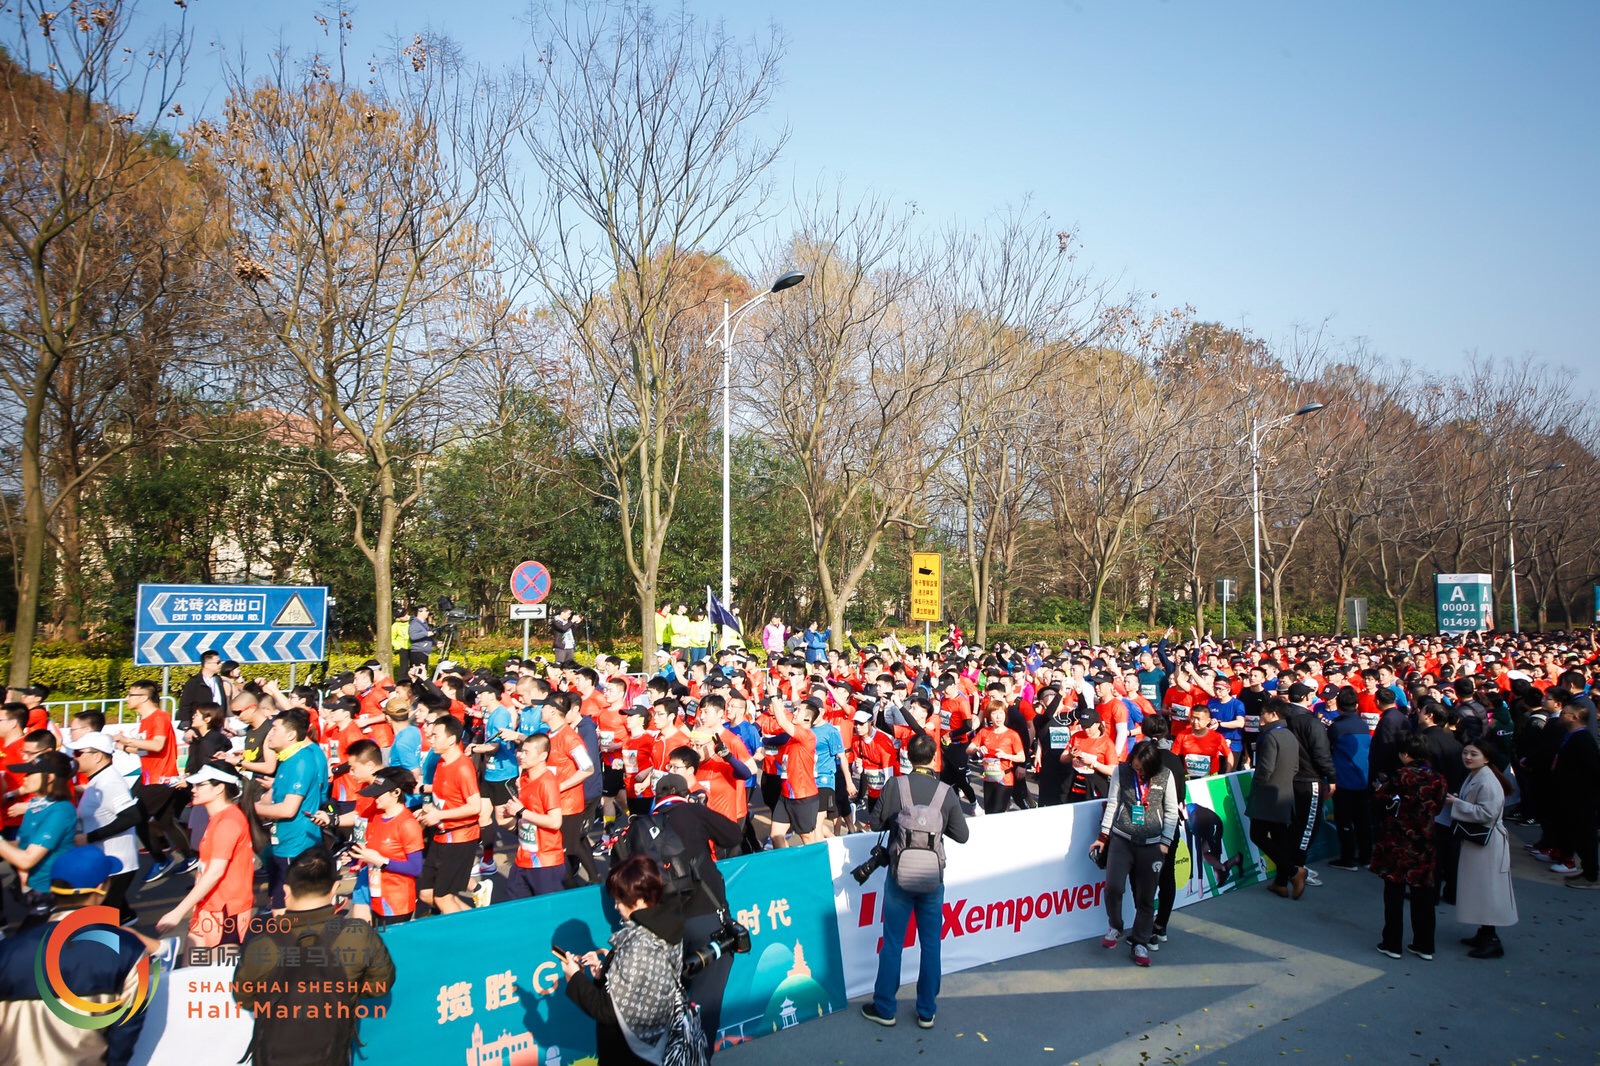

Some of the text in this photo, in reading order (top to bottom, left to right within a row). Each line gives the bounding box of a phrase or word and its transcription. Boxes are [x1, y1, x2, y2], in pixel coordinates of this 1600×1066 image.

[1450, 585, 1466, 602] A
[173, 597, 261, 612] 沈砖公路出口
[1442, 603, 1476, 612] 00001
[172, 613, 260, 621] EXIT TO SHENZHUAN RD.
[1442, 618, 1477, 627] 01499
[436, 969, 519, 1025] 揽胜
[737, 898, 792, 936] 时代
